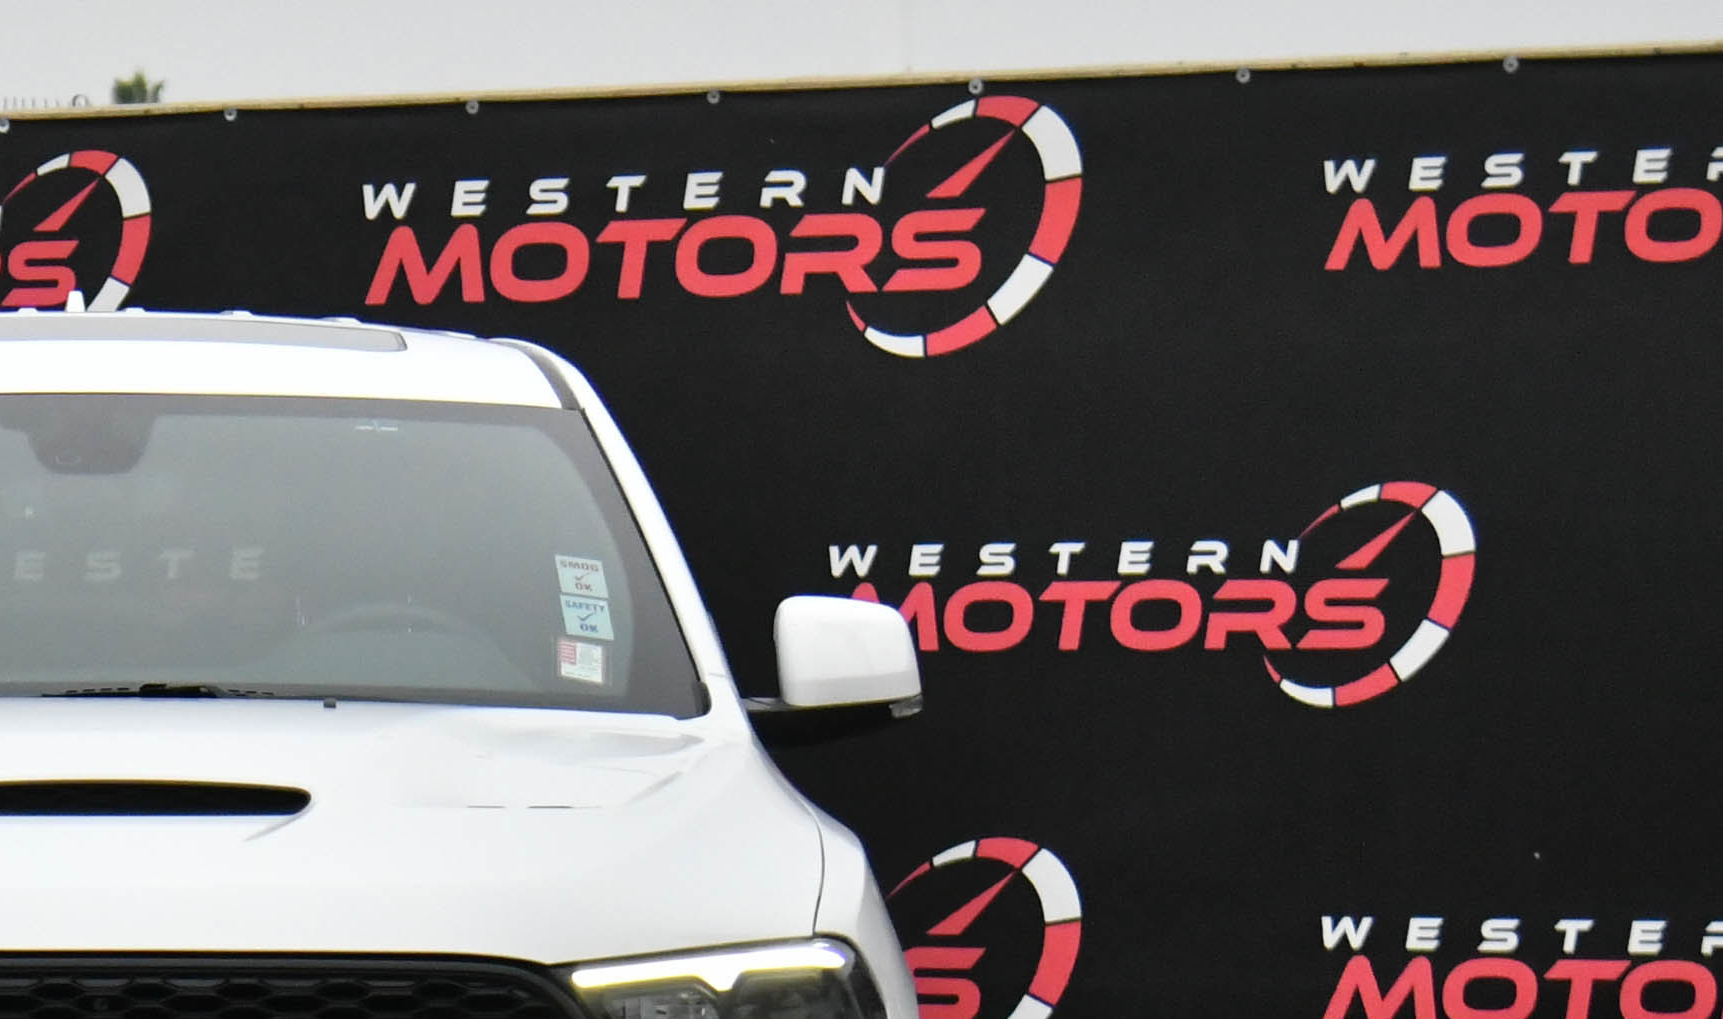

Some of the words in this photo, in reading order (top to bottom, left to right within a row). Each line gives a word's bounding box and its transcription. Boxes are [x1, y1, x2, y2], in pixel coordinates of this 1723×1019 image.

[362, 165, 886, 220] WESTERN
[365, 207, 986, 306] MOTORS
[1325, 187, 1723, 271] MOTO
[828, 539, 1301, 578] WESTERN
